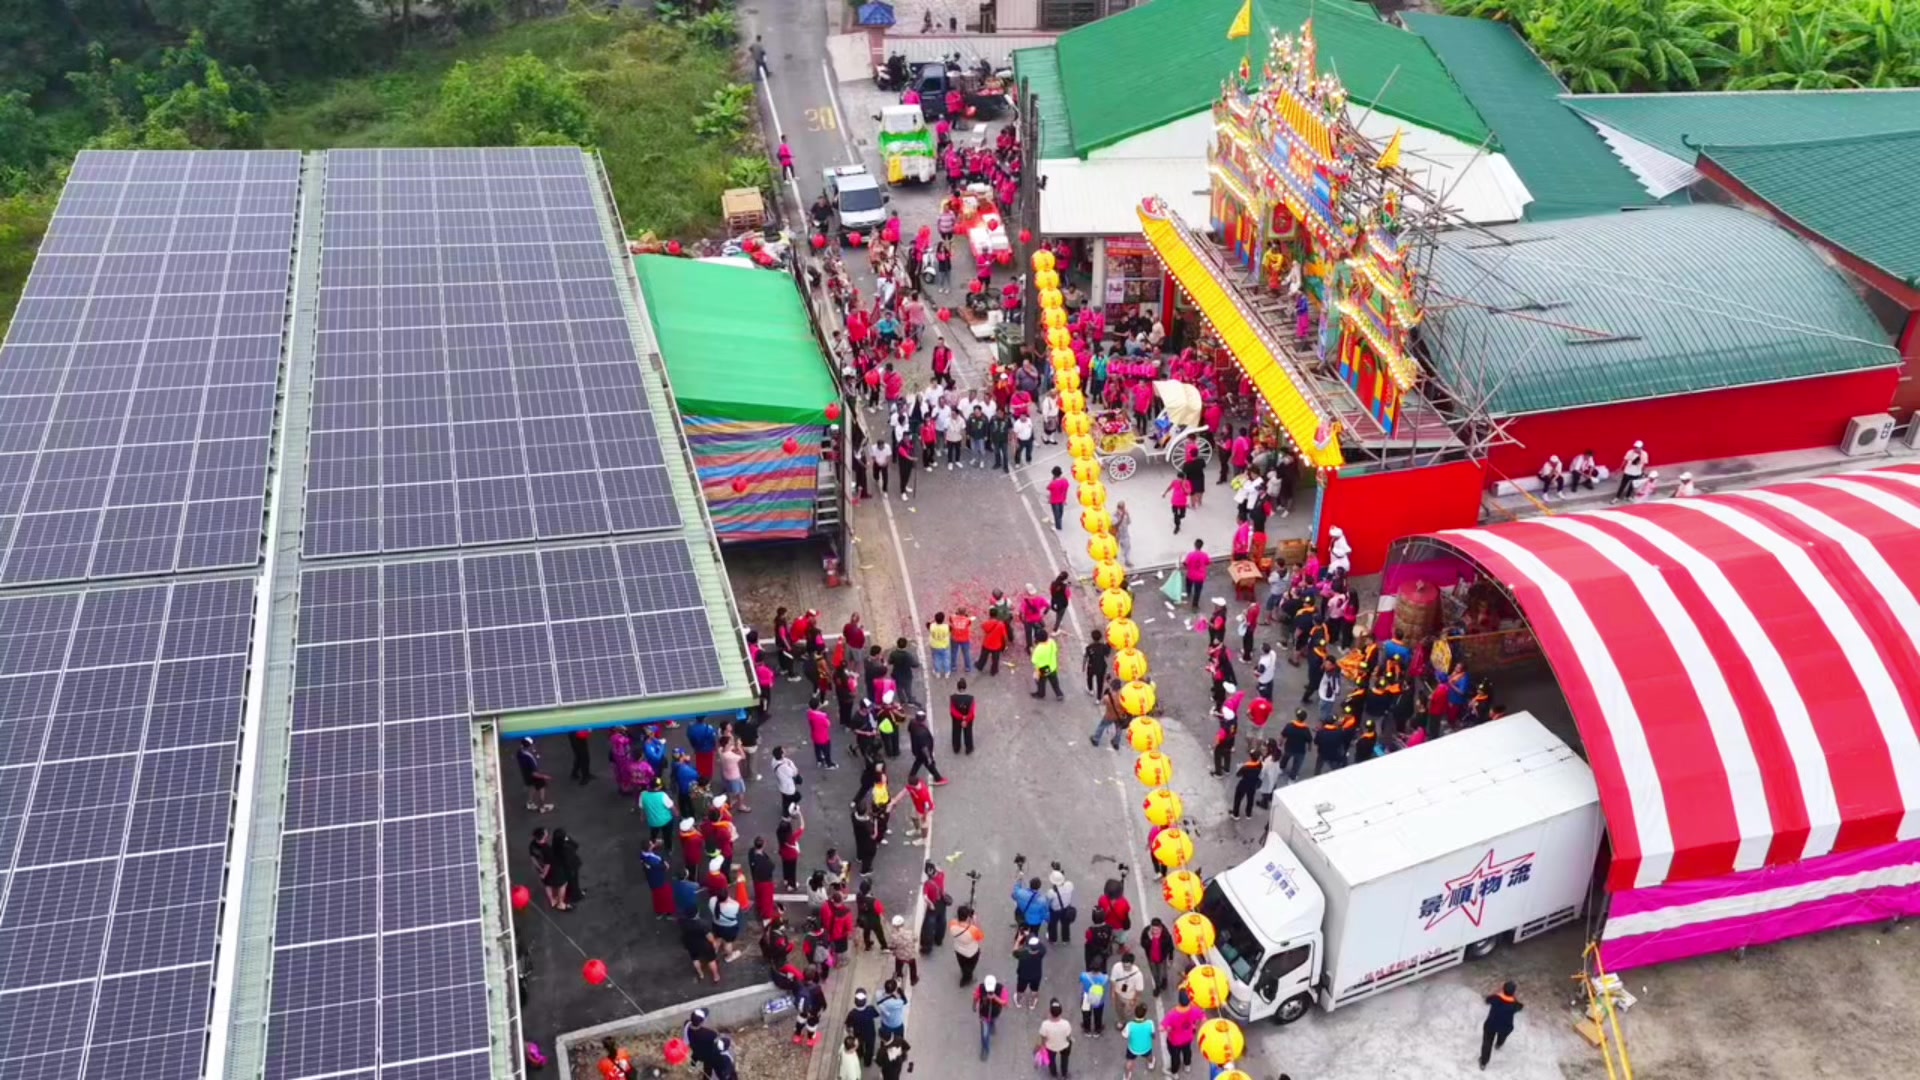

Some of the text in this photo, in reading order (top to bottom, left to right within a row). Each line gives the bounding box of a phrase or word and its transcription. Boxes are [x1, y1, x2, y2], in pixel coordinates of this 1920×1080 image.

[804, 107, 837, 131] 30
[1418, 863, 1533, 919] 景順物流
